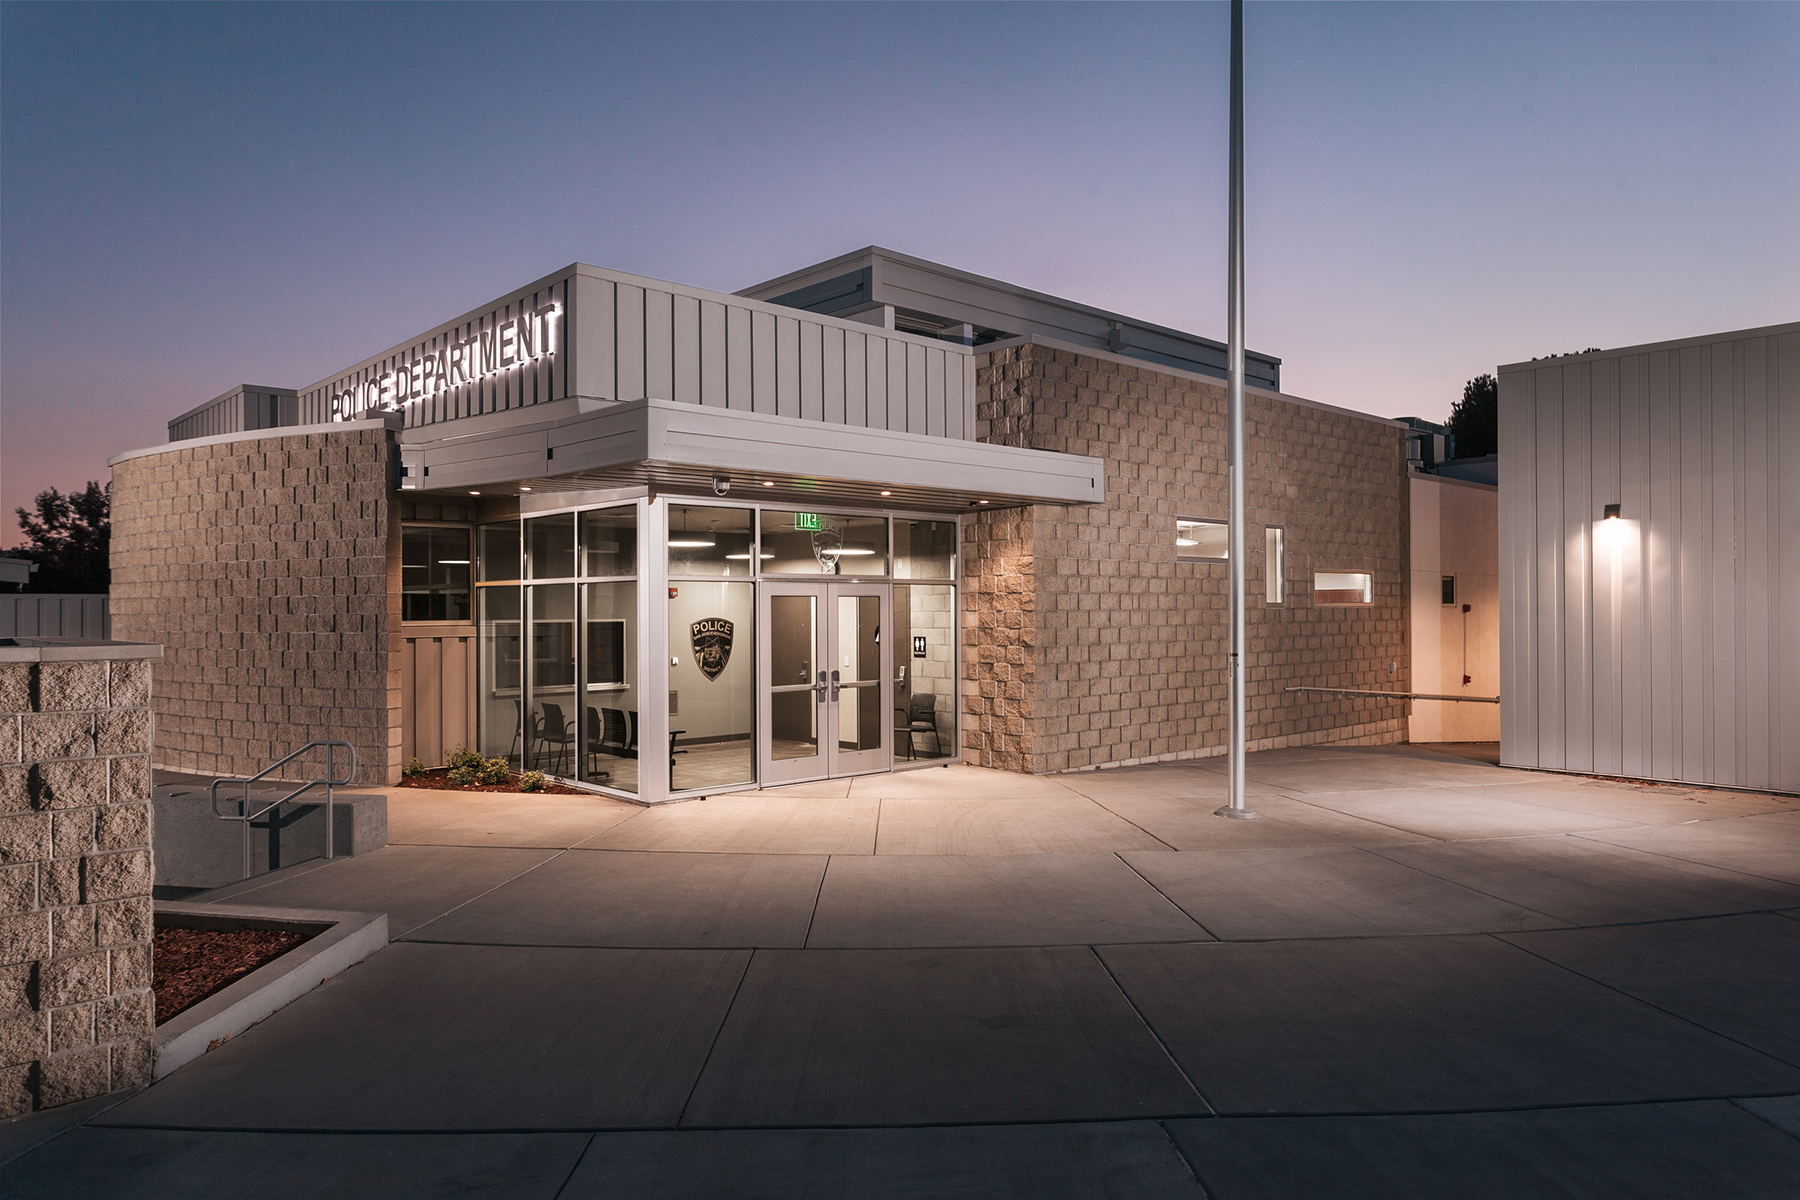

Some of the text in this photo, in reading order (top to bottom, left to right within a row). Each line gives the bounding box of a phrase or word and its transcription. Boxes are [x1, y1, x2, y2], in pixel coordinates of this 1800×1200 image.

[331, 303, 556, 422] POLICE DEPARTMENT
[693, 621, 732, 634] POLICE
